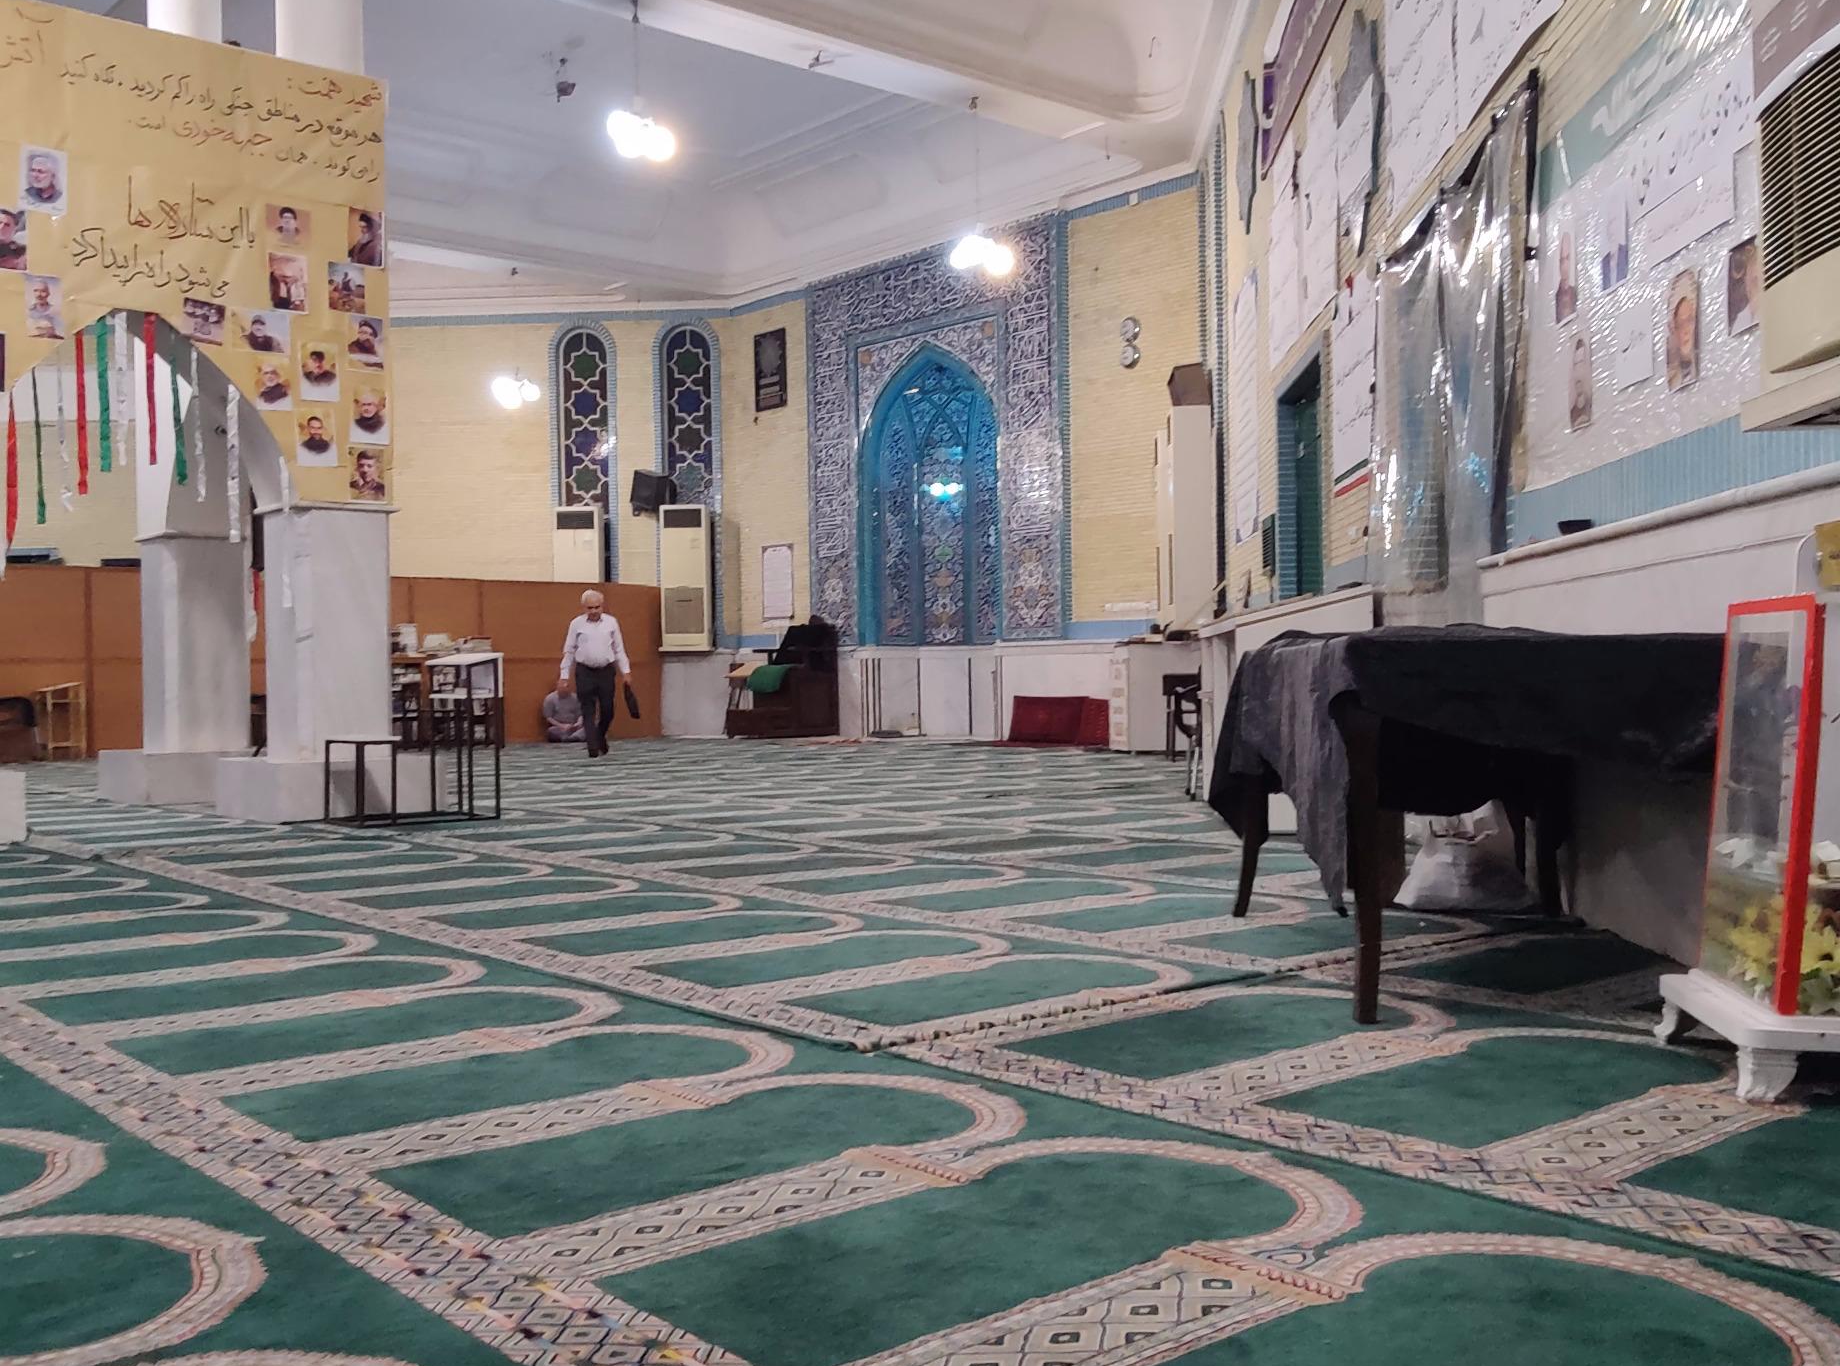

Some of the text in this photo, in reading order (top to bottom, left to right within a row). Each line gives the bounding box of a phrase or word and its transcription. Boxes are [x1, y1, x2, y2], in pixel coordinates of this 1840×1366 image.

[344, 82, 382, 113] شهید
[356, 132, 381, 146] هر
[175, 263, 211, 294] شود
